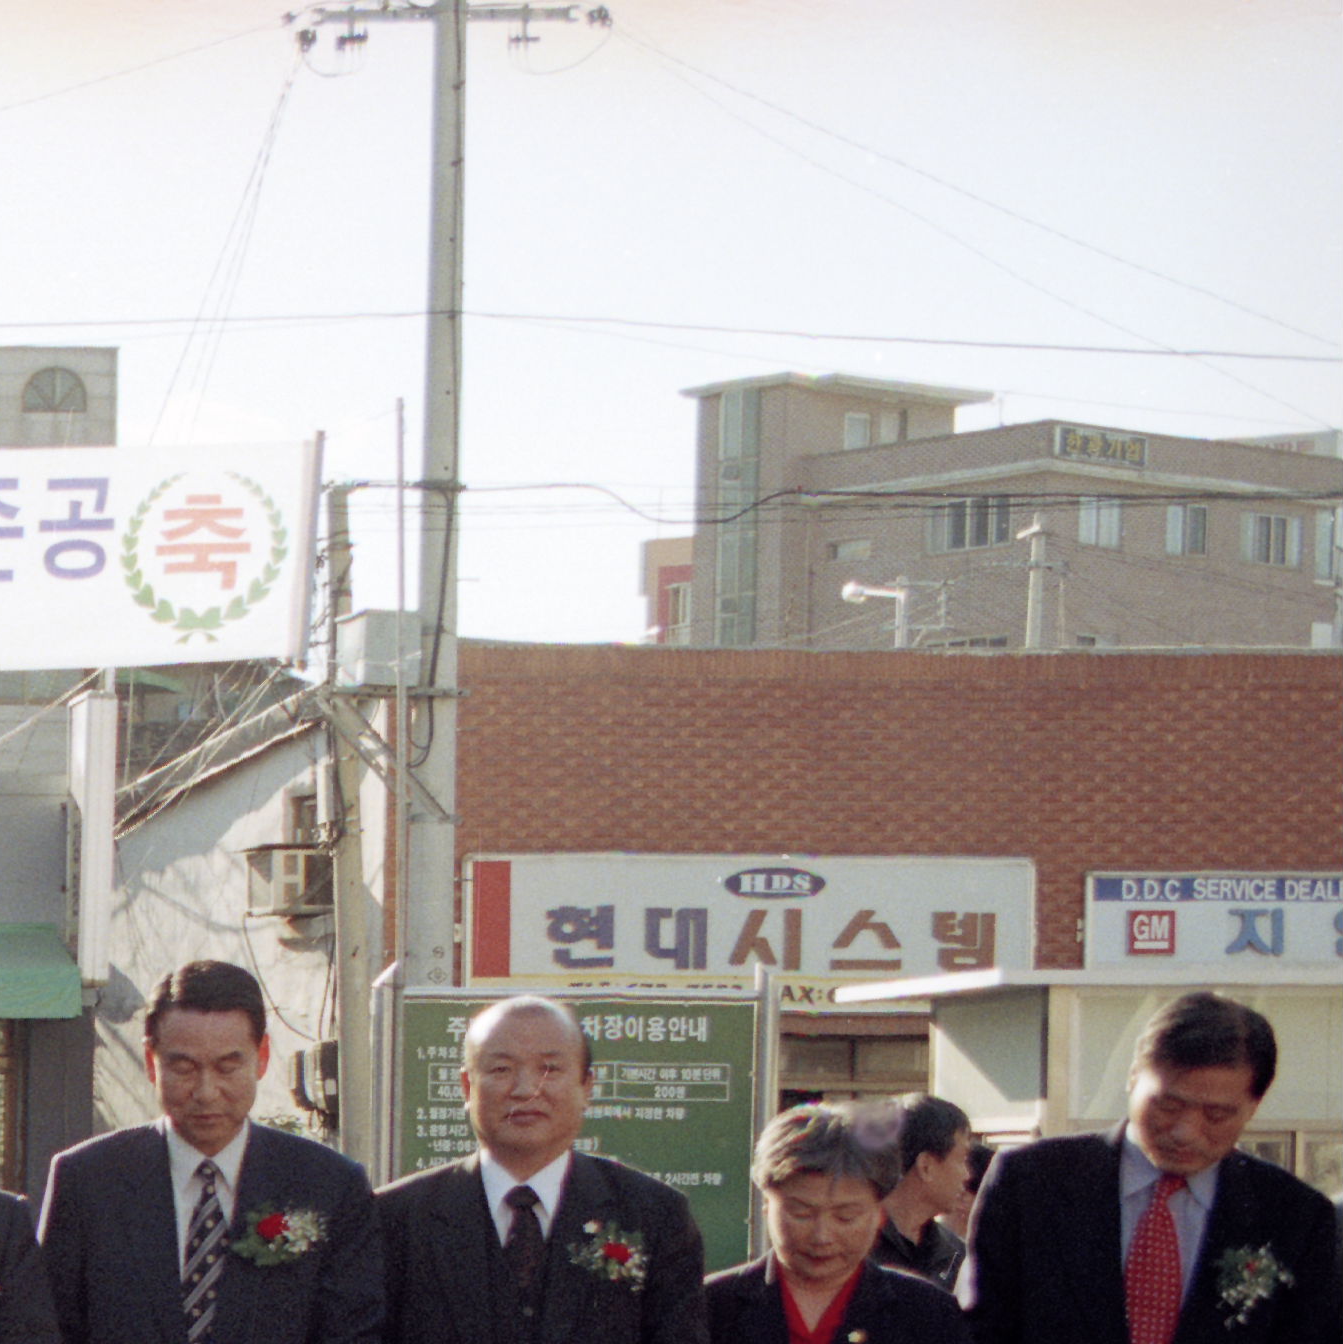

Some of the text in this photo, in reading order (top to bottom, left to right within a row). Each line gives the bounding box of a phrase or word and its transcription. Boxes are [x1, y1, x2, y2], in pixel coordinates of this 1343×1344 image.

[155, 493, 251, 590] 축
[738, 873, 812, 895] HDS
[1192, 879, 1278, 900] SERVICE
[545, 904, 997, 971] 현대시스템
[1133, 914, 1170, 940] GM
